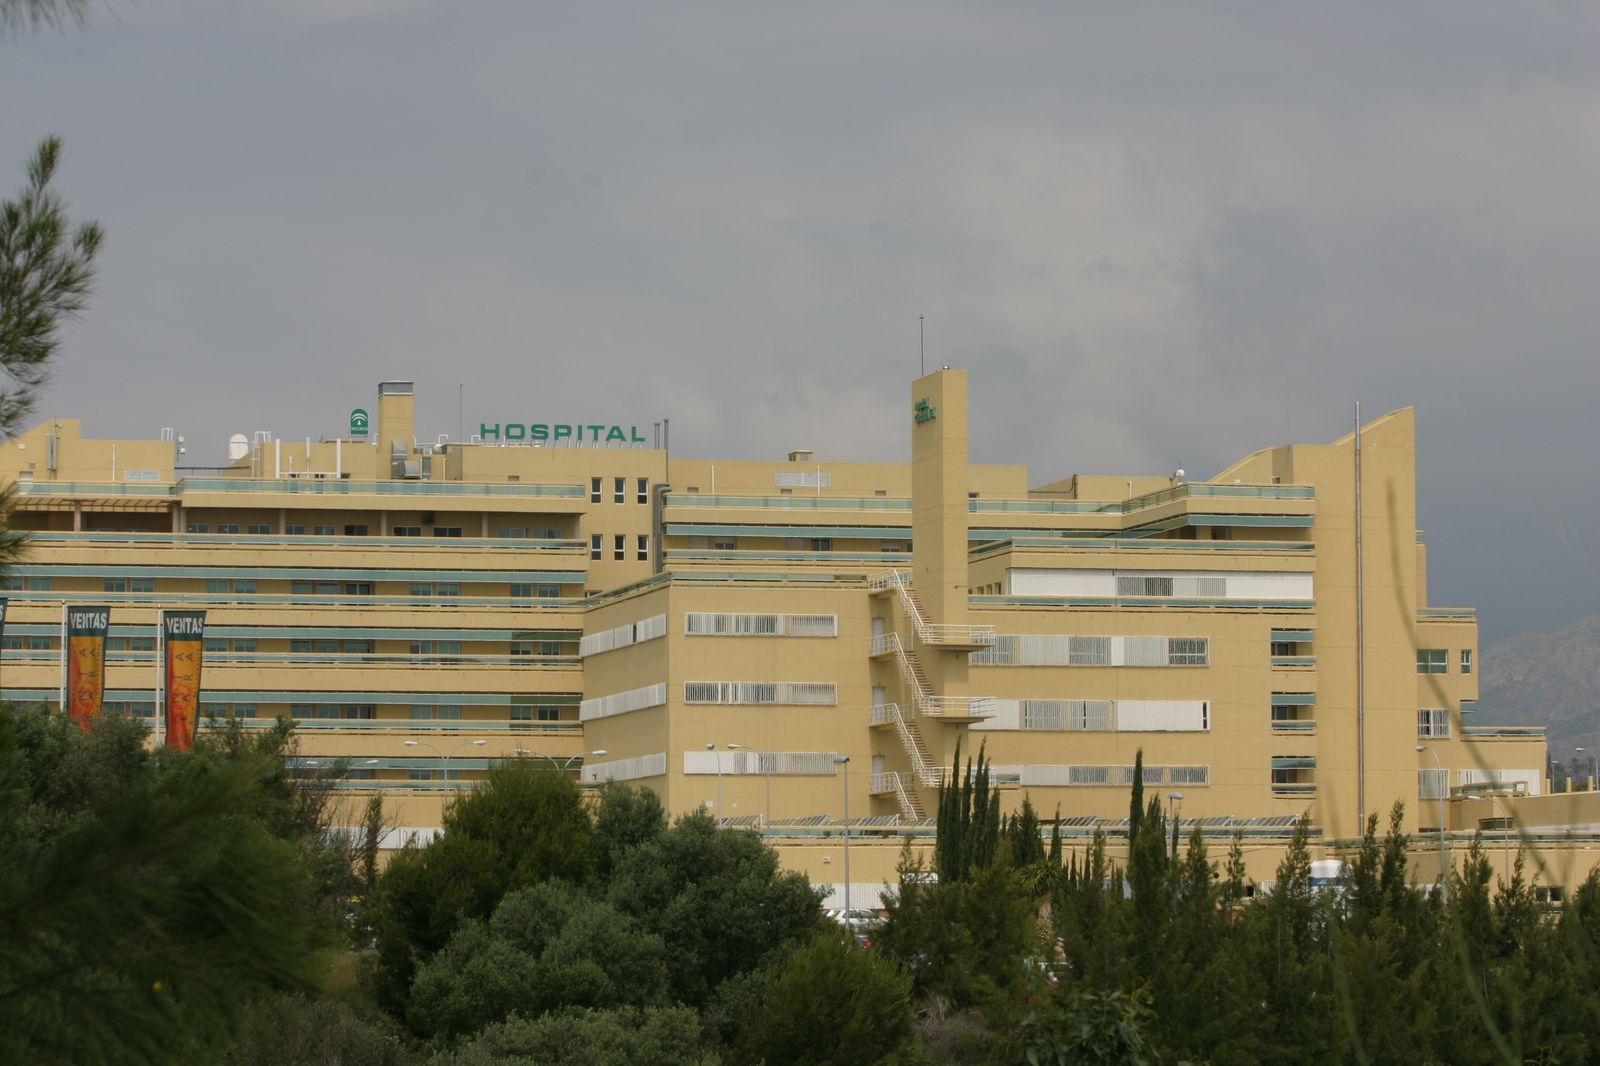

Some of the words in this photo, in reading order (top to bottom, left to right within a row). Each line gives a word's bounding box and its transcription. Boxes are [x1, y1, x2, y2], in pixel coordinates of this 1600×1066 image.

[480, 423, 646, 442] HOSPITAL
[70, 612, 107, 629] VENTAS
[166, 617, 203, 634] VENTAS
